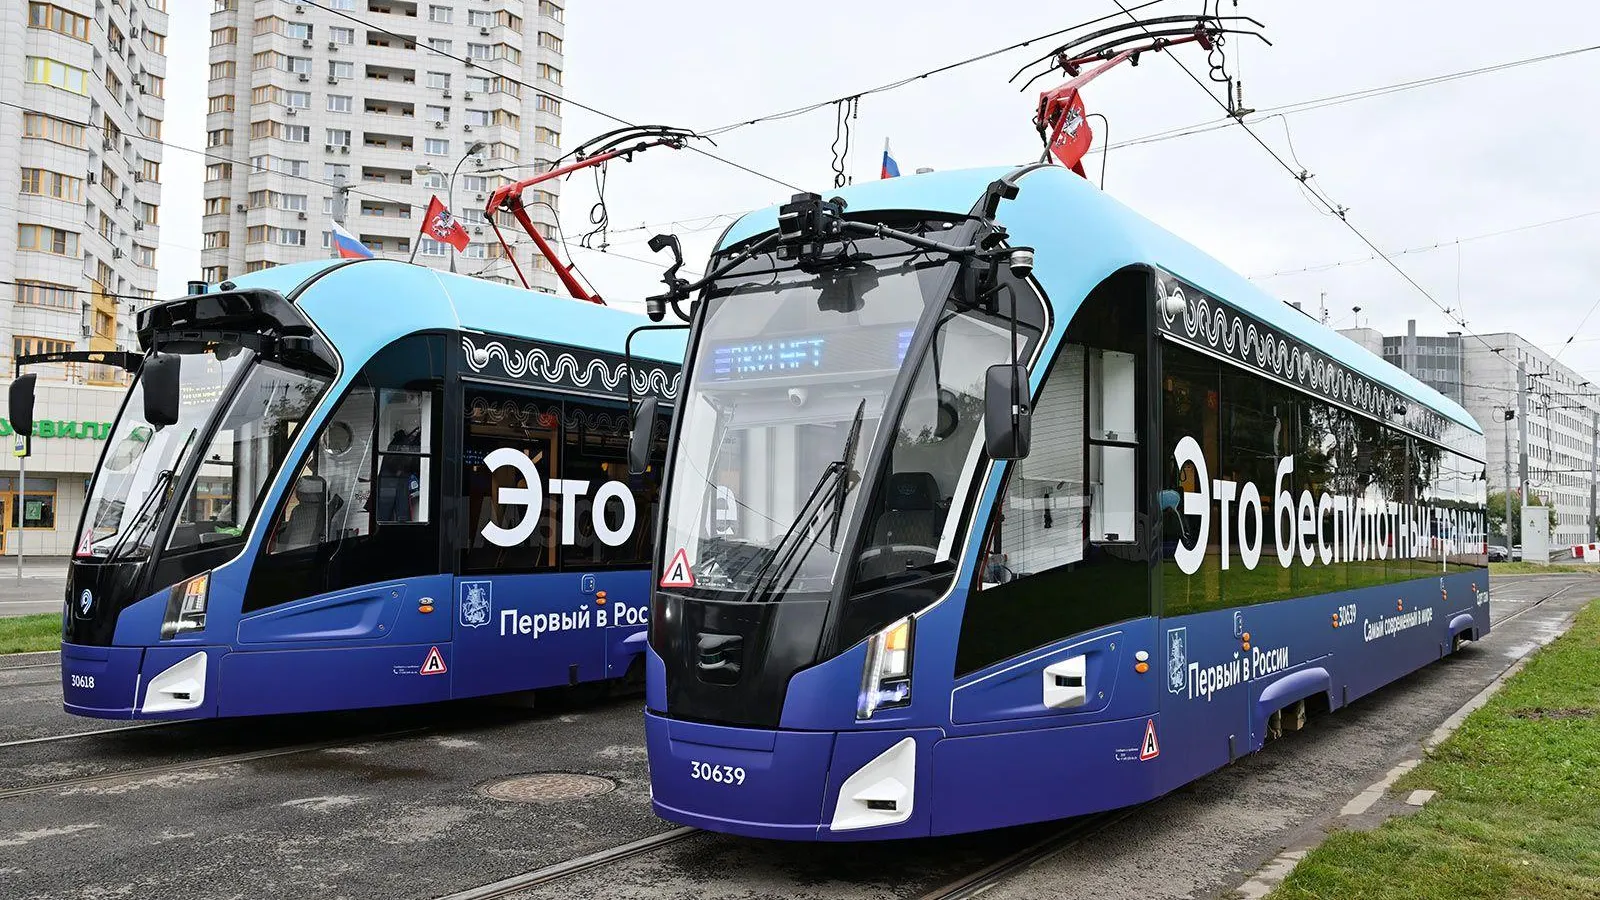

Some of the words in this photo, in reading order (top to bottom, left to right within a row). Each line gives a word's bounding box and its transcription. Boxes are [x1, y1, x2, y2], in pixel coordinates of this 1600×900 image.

[480, 447, 637, 547] Это
[1173, 435, 1262, 575] Это
[1274, 454, 1432, 569] беспилотный
[500, 604, 590, 639] Первый
[596, 609, 608, 628] в
[1338, 603, 1357, 627] 30639
[1363, 614, 1384, 642] Самый
[71, 674, 95, 689] 30618
[1188, 651, 1241, 702] Первый
[1243, 657, 1251, 681] в
[1252, 646, 1289, 679] России
[690, 760, 746, 786] 30639
